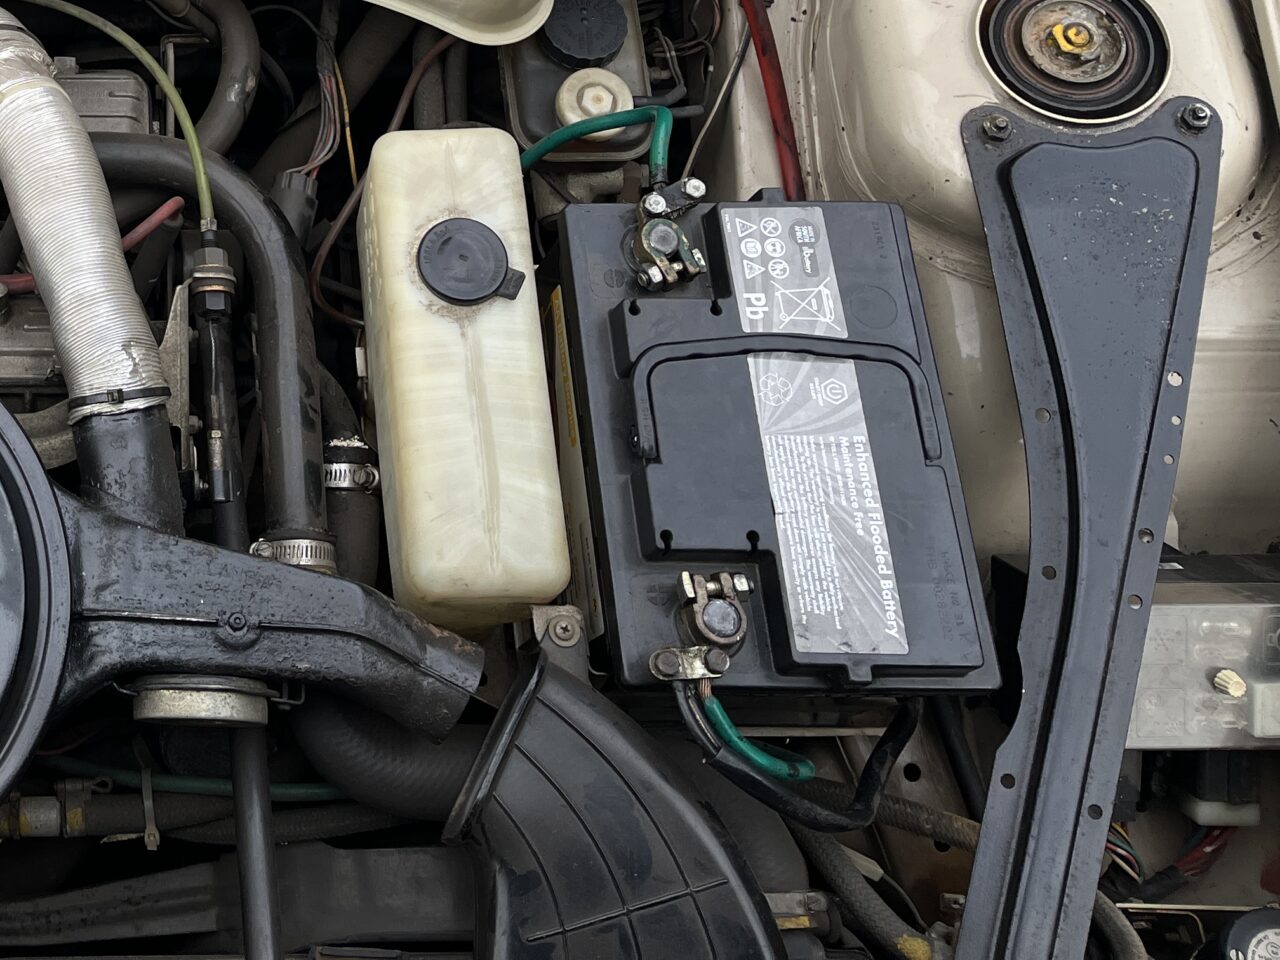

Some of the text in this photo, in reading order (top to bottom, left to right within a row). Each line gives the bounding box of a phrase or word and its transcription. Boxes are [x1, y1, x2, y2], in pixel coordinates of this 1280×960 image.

[743, 292, 768, 320] Pb
[839, 436, 865, 536] Maintenance Free
[852, 435, 899, 638] Enhanced Flooded Battery
